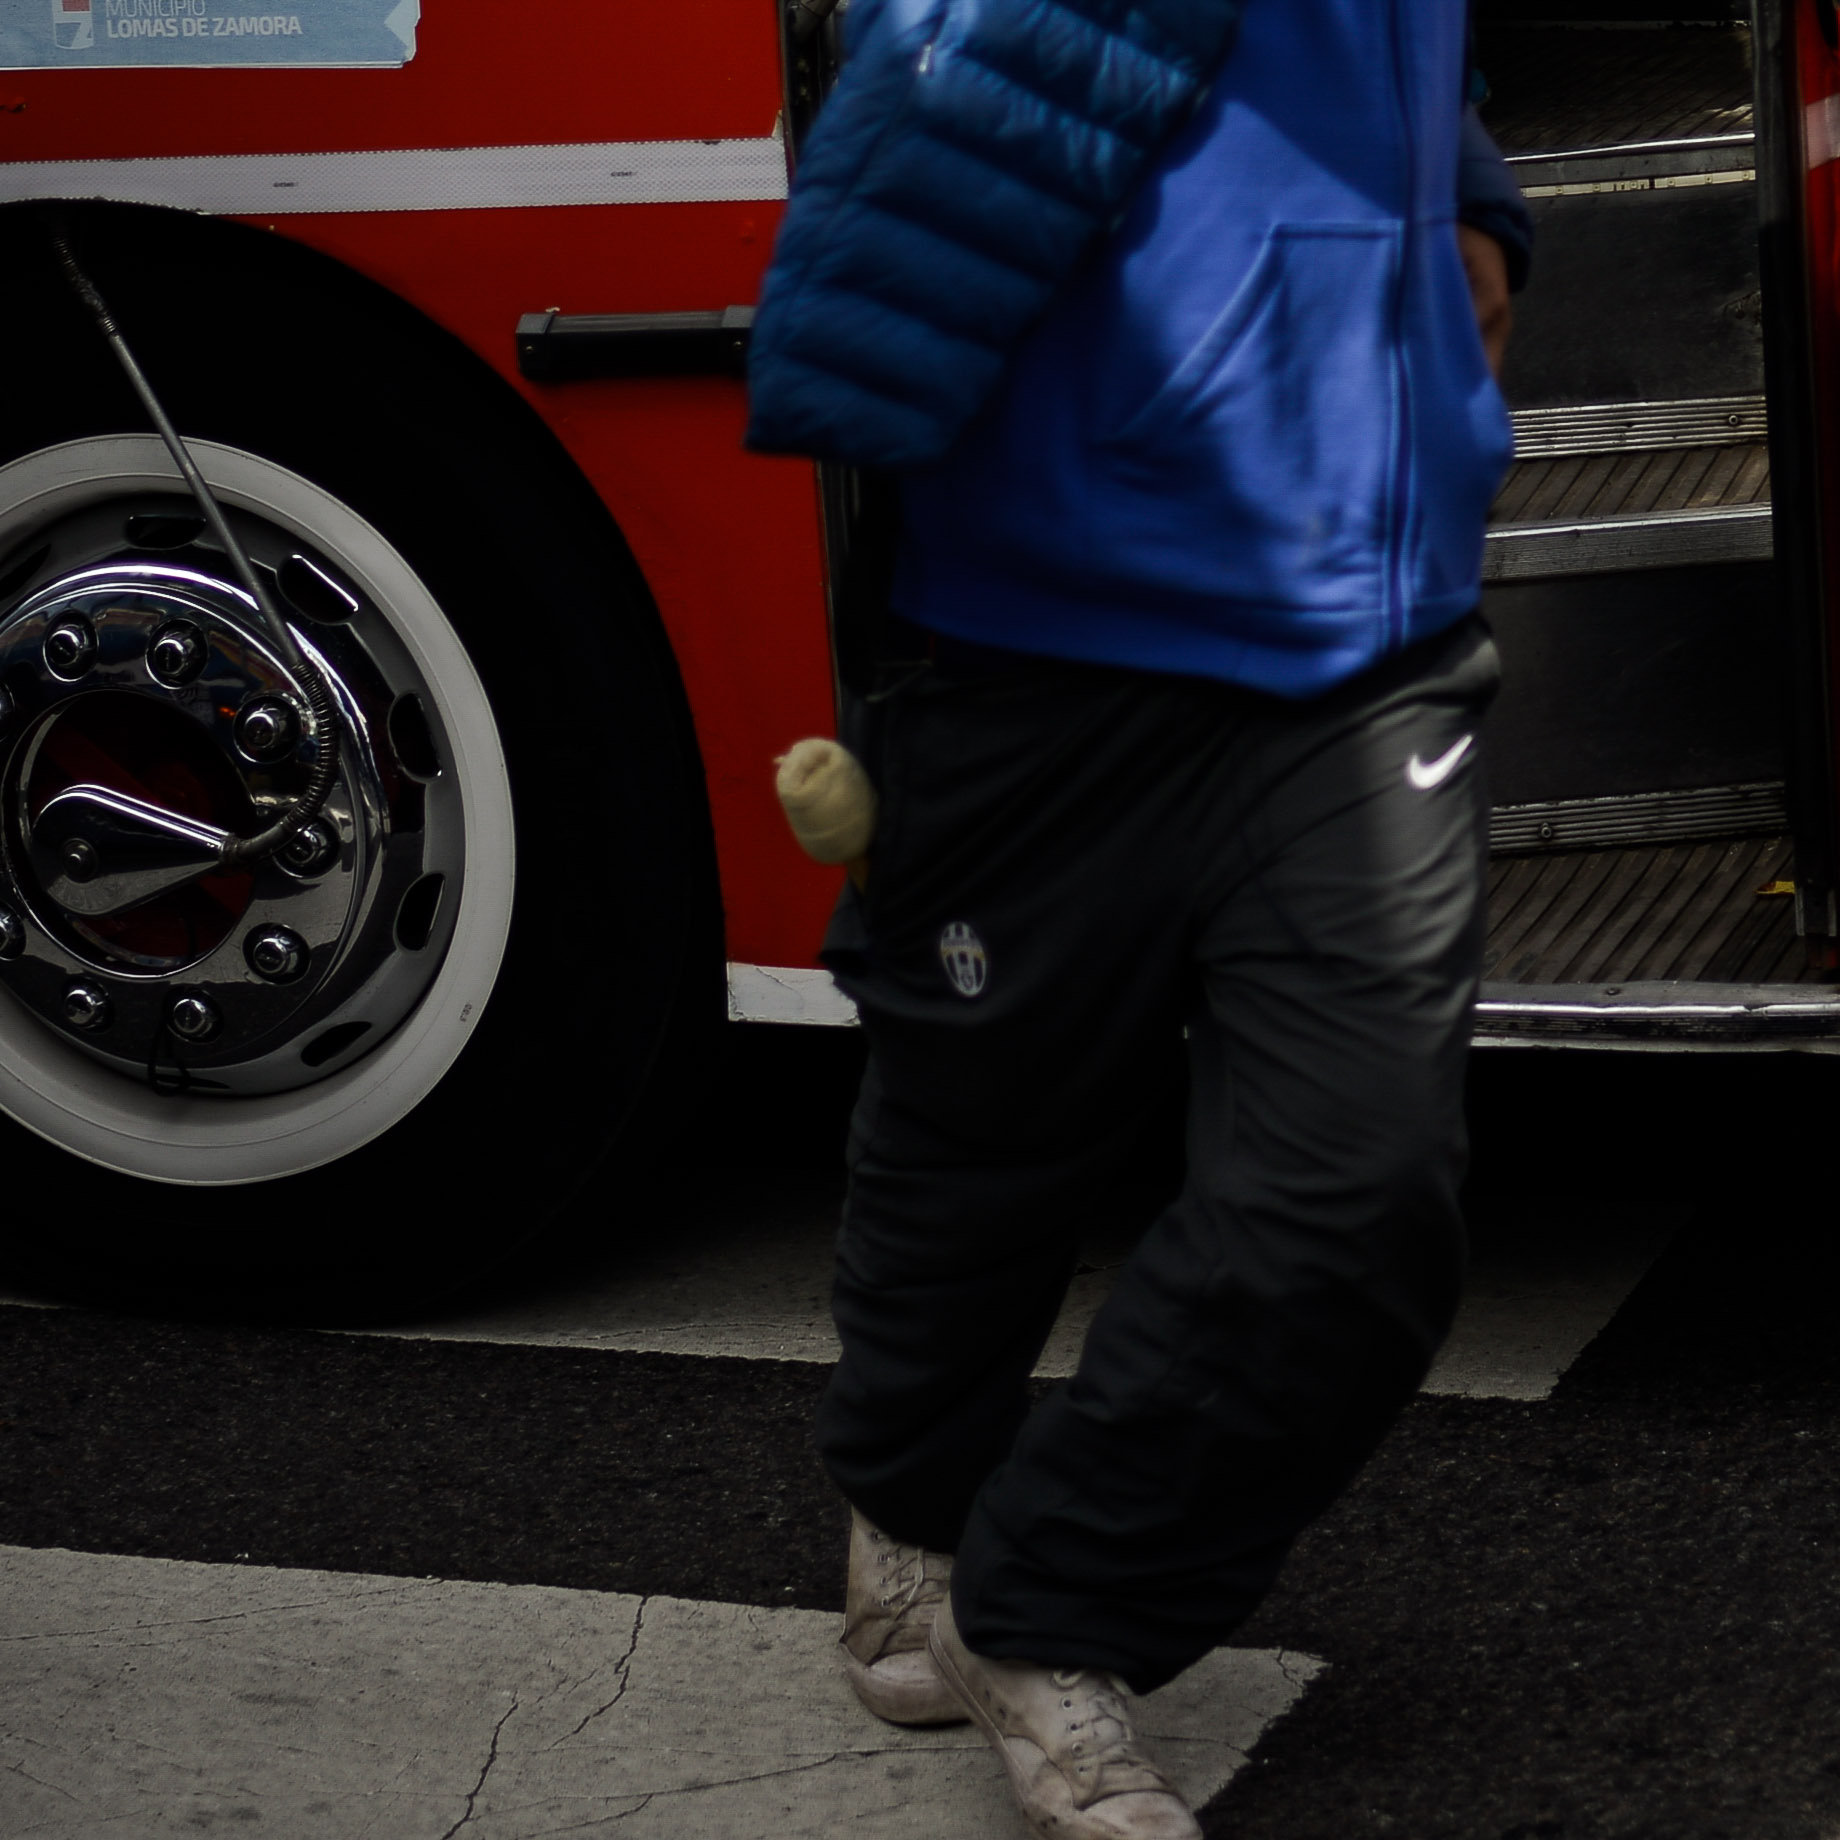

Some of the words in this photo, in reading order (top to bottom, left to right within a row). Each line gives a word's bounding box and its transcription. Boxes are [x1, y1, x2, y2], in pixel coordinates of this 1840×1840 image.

[106, 18, 179, 39] LOMAS
[182, 18, 210, 38] DE
[212, 15, 303, 37] ZAMORA
